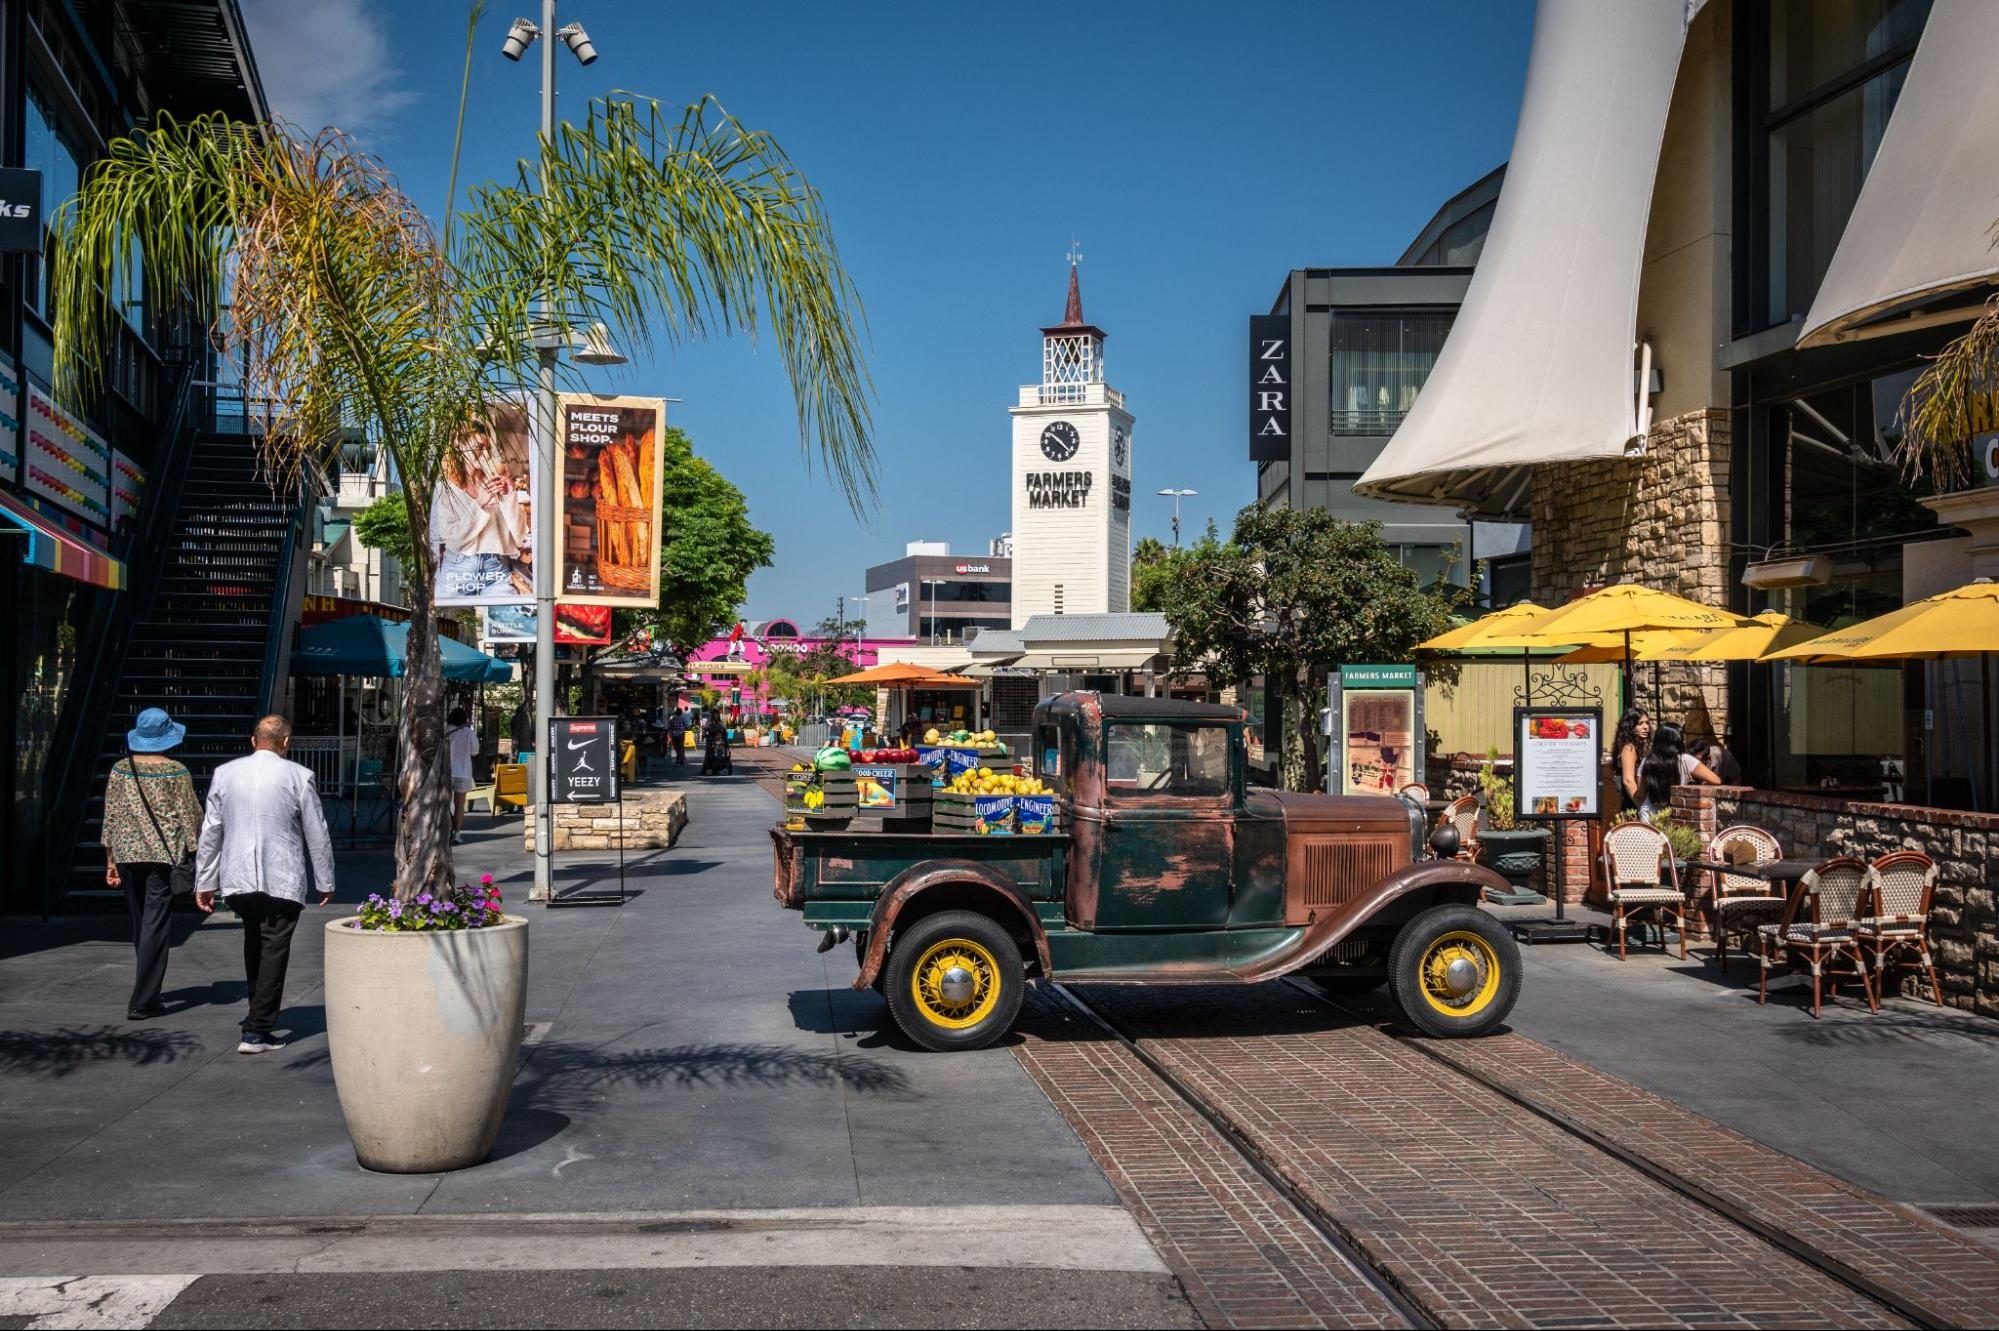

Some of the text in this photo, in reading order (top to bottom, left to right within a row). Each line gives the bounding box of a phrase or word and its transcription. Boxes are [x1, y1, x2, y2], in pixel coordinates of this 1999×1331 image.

[1257, 339, 1287, 436] ZARA
[571, 412, 619, 423] MEETS
[571, 422, 618, 434] FLOUR
[570, 433, 613, 444] SHOP.
[1026, 471, 1092, 491] FARMERS
[1029, 490, 1089, 509] MARKET
[446, 571, 506, 581] FLOWER
[447, 583, 486, 592] SHOP
[1345, 671, 1412, 680] FARMERS MARKET
[569, 723, 596, 733] Supreme
[856, 769, 871, 777] OOD
[568, 776, 600, 788] YEEZY
[976, 797, 1053, 816] LOCOMOTIVE ENGINEER
